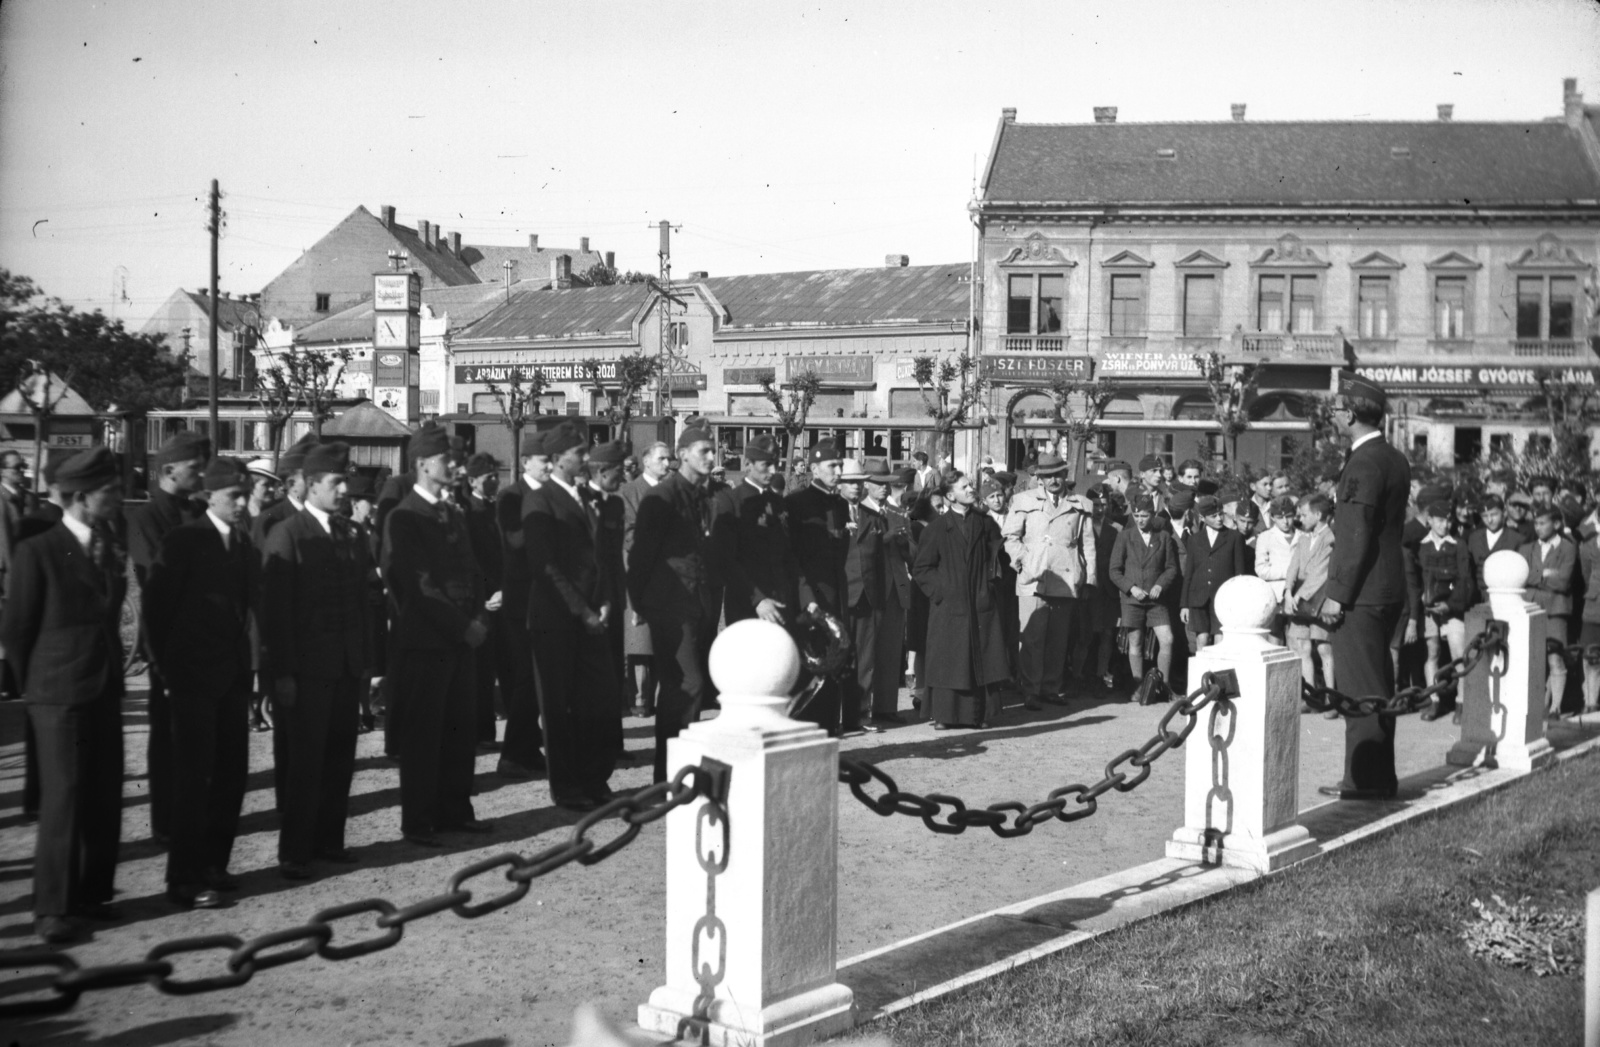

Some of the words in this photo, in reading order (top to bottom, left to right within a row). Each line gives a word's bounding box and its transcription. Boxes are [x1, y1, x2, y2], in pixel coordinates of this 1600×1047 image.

[1105, 352, 1164, 361] WIENER
[573, 363, 584, 379] ÉS
[1136, 360, 1178, 371] PONYVA
[1419, 365, 1473, 383] JÓZSEF
[57, 435, 83, 446] PEST
